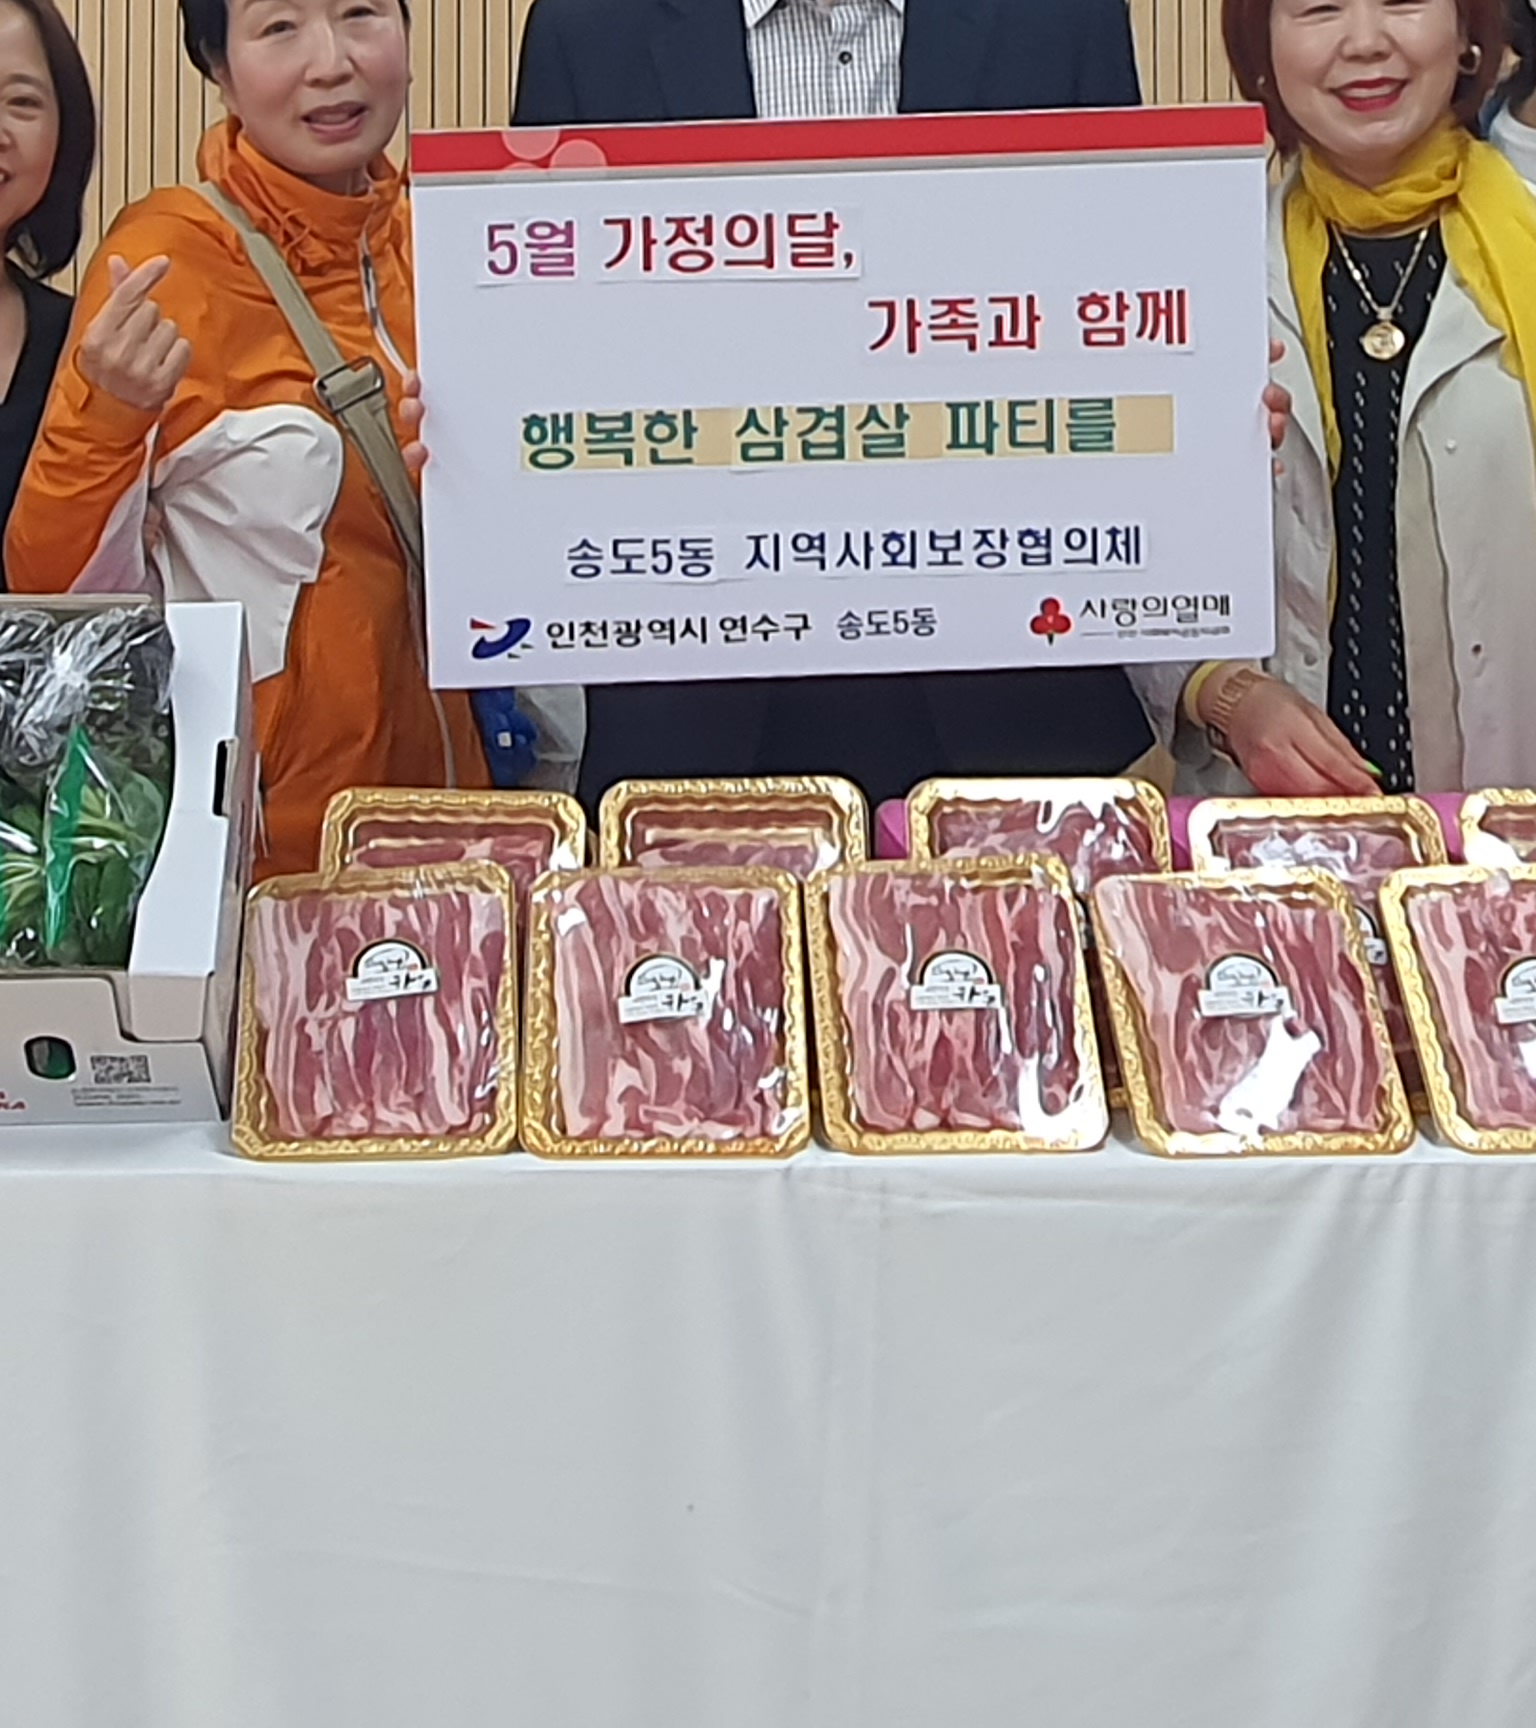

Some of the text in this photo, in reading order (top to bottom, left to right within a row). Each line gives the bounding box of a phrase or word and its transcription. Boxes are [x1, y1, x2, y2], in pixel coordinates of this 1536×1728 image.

[488, 210, 855, 277] 5월 가정의달,
[868, 289, 1186, 354] 가족과 함께
[521, 397, 1119, 470] 행복한 삼겹살 파티를
[566, 525, 1142, 582] 송도5동 지역사회보장협의체
[546, 608, 936, 649] 인천광역시 연수구 송도5동
[1080, 595, 1230, 628] 사랑의열매
